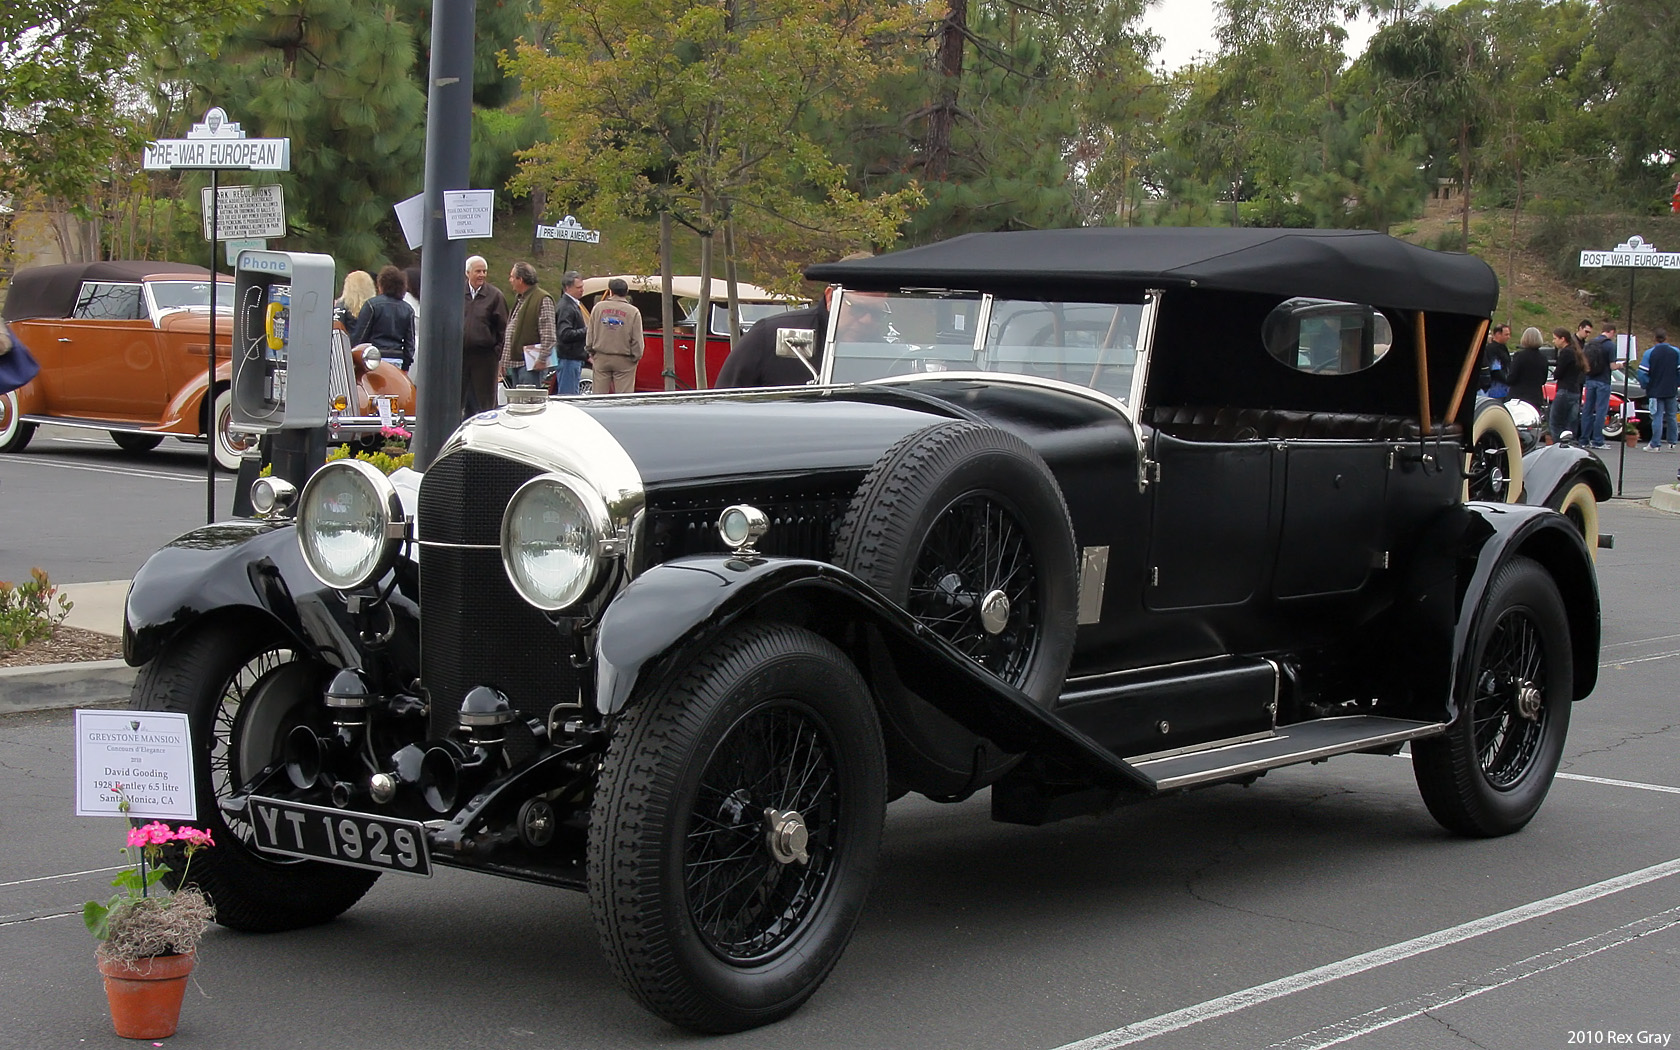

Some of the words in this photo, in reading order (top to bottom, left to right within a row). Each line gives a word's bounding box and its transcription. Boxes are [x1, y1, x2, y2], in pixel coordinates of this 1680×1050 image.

[150, 144, 205, 164] PRE-WAR
[209, 143, 277, 165] EUROPEAN
[233, 189, 272, 198] REGULATIONS
[544, 228, 568, 238] PRE-WAR
[570, 230, 597, 241] AMERICAN
[243, 257, 286, 270] Phone
[1582, 253, 1630, 266] POST-WAR
[1634, 254, 1680, 267] EUROPEAN
[89, 732, 139, 742] GREYSTONE
[141, 735, 180, 744] MANSION
[106, 745, 134, 753] Concours
[135, 746, 166, 755] d'Elegance
[104, 767, 130, 777] David
[132, 768, 169, 780] Gooding
[94, 780, 113, 789] 1928
[148, 783, 160, 791] 6.5
[162, 783, 179, 792] litre
[125, 794, 159, 806] Monica,
[161, 796, 174, 805] CA
[257, 805, 306, 850] YT
[322, 816, 418, 868] 1929
